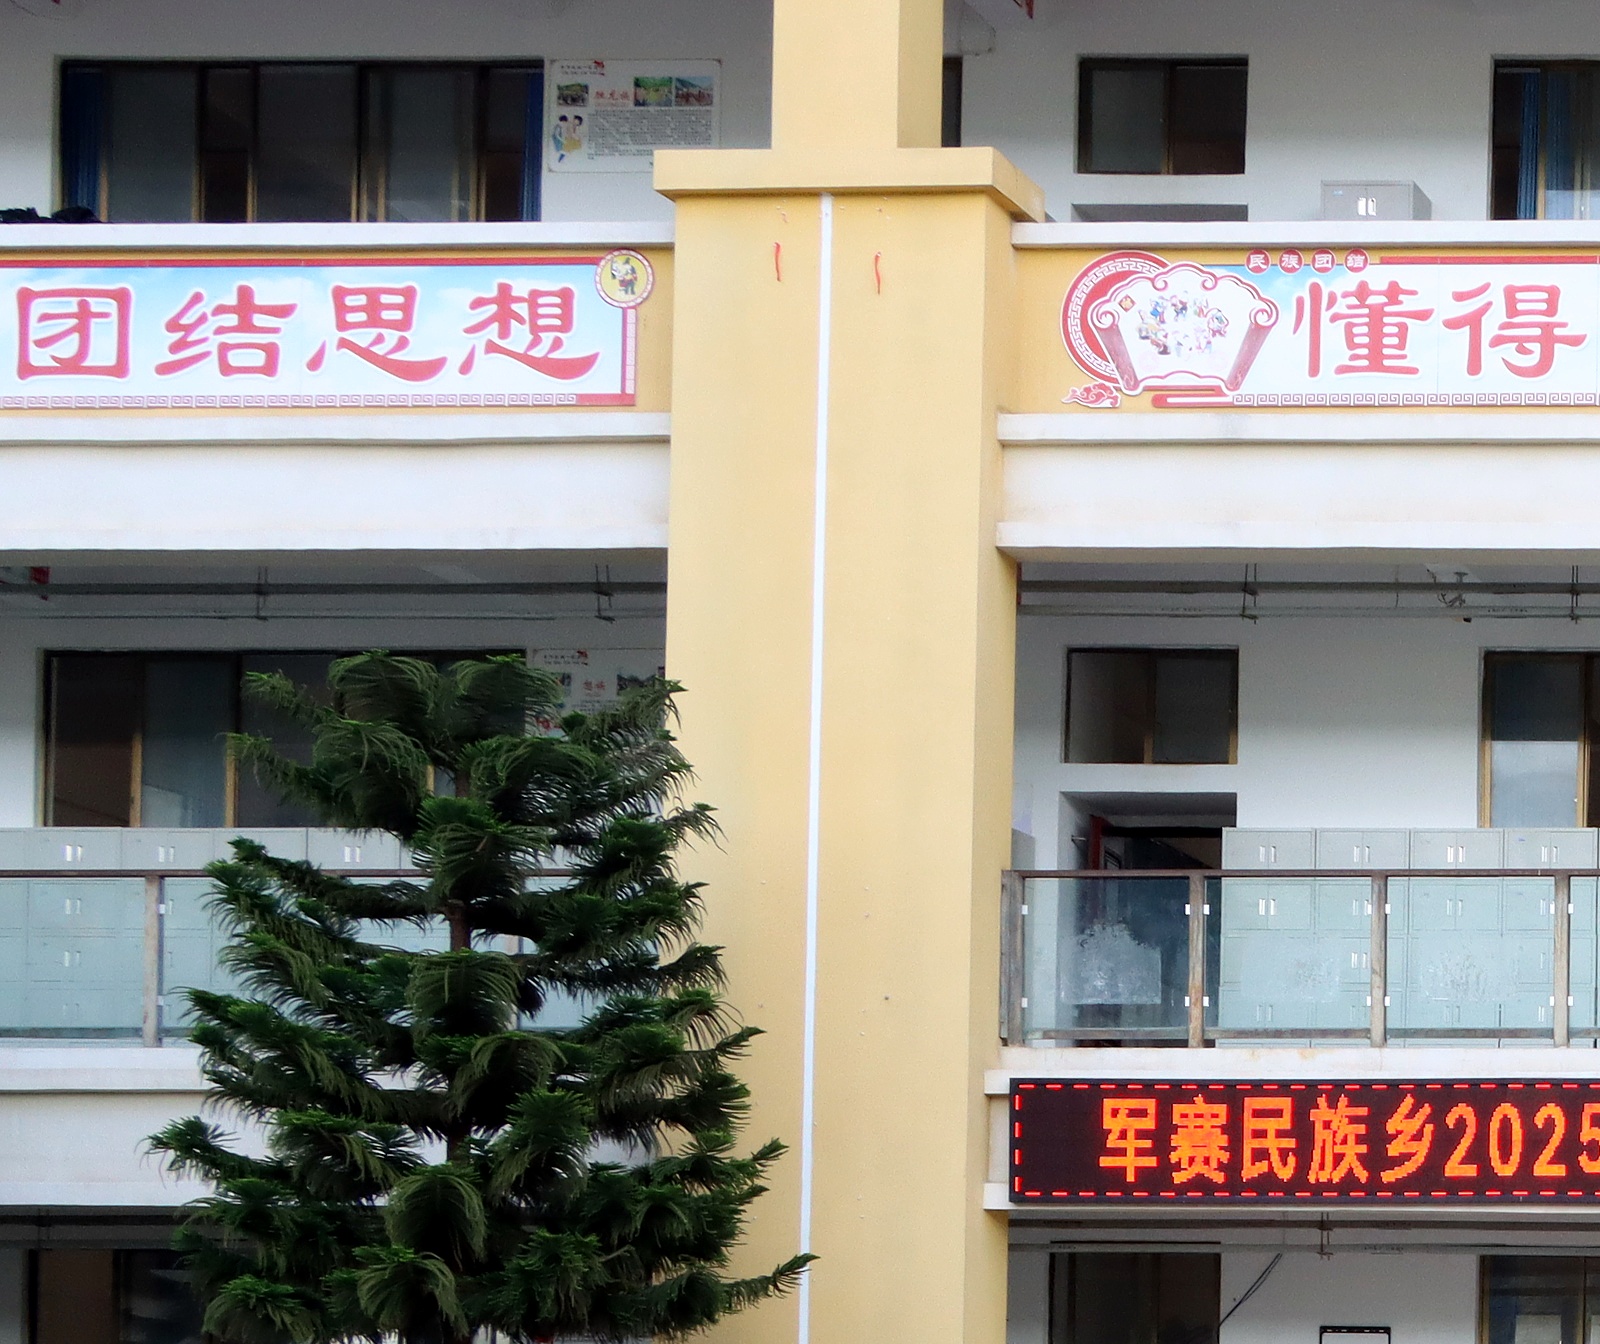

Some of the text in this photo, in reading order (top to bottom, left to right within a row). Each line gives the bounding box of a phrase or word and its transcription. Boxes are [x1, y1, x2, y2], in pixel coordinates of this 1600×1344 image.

[1248, 253, 1366, 269] 民族团结
[16, 283, 599, 382] 团结思想
